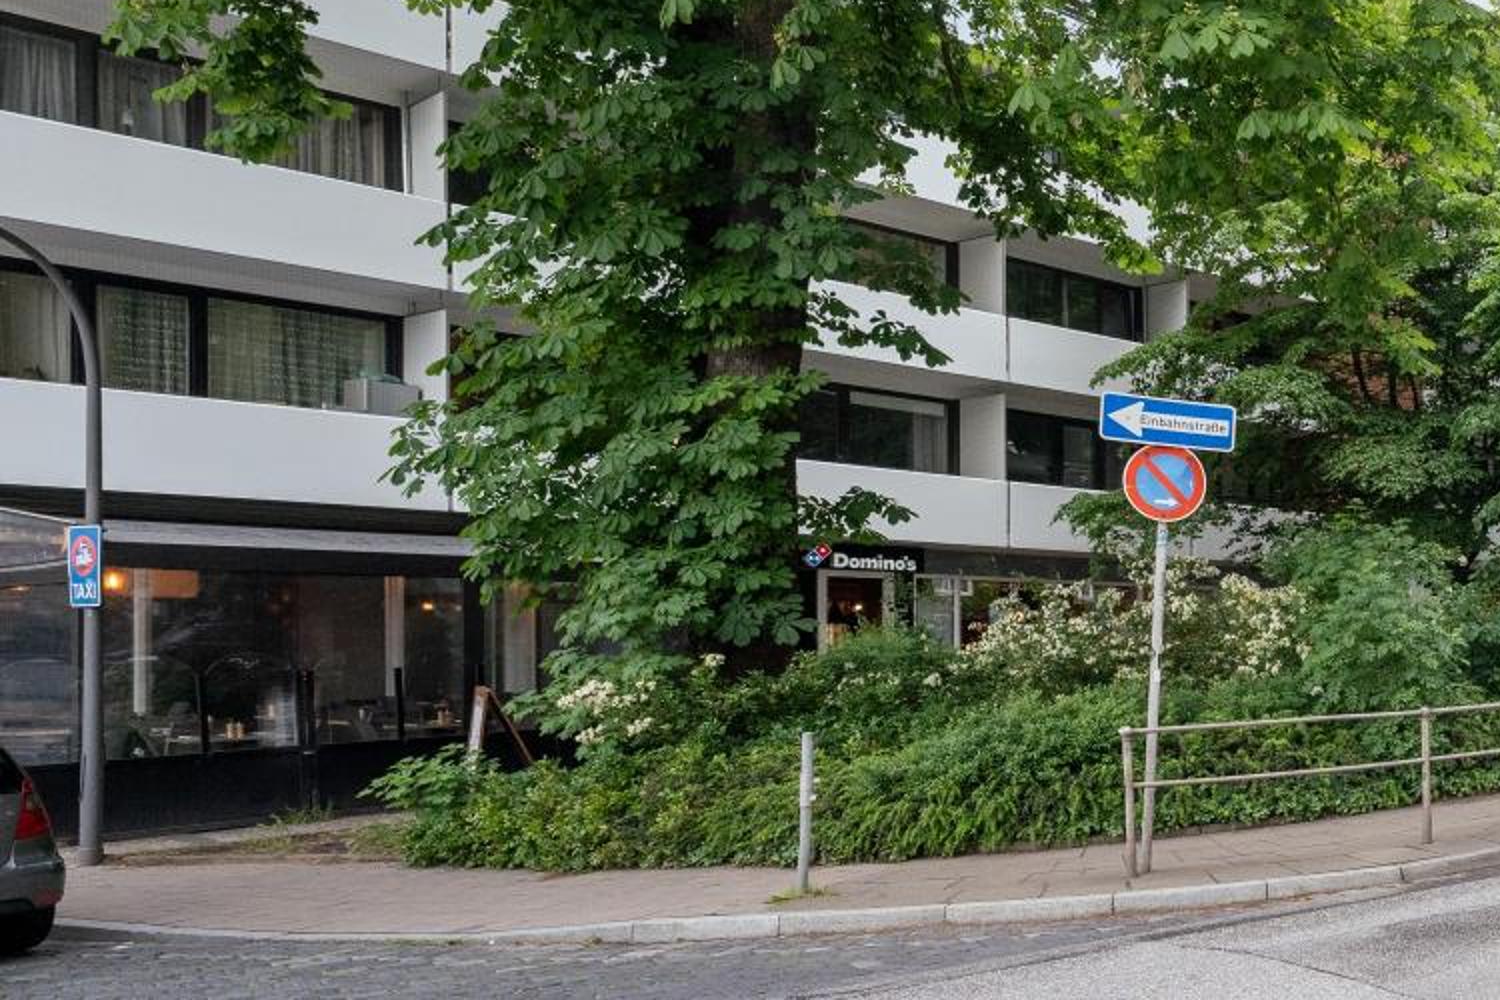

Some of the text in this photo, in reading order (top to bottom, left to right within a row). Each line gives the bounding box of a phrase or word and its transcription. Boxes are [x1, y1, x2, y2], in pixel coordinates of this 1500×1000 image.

[1139, 412, 1227, 434] Einbahnstraße
[832, 552, 918, 571] Domino's
[72, 583, 97, 599] TAXI
